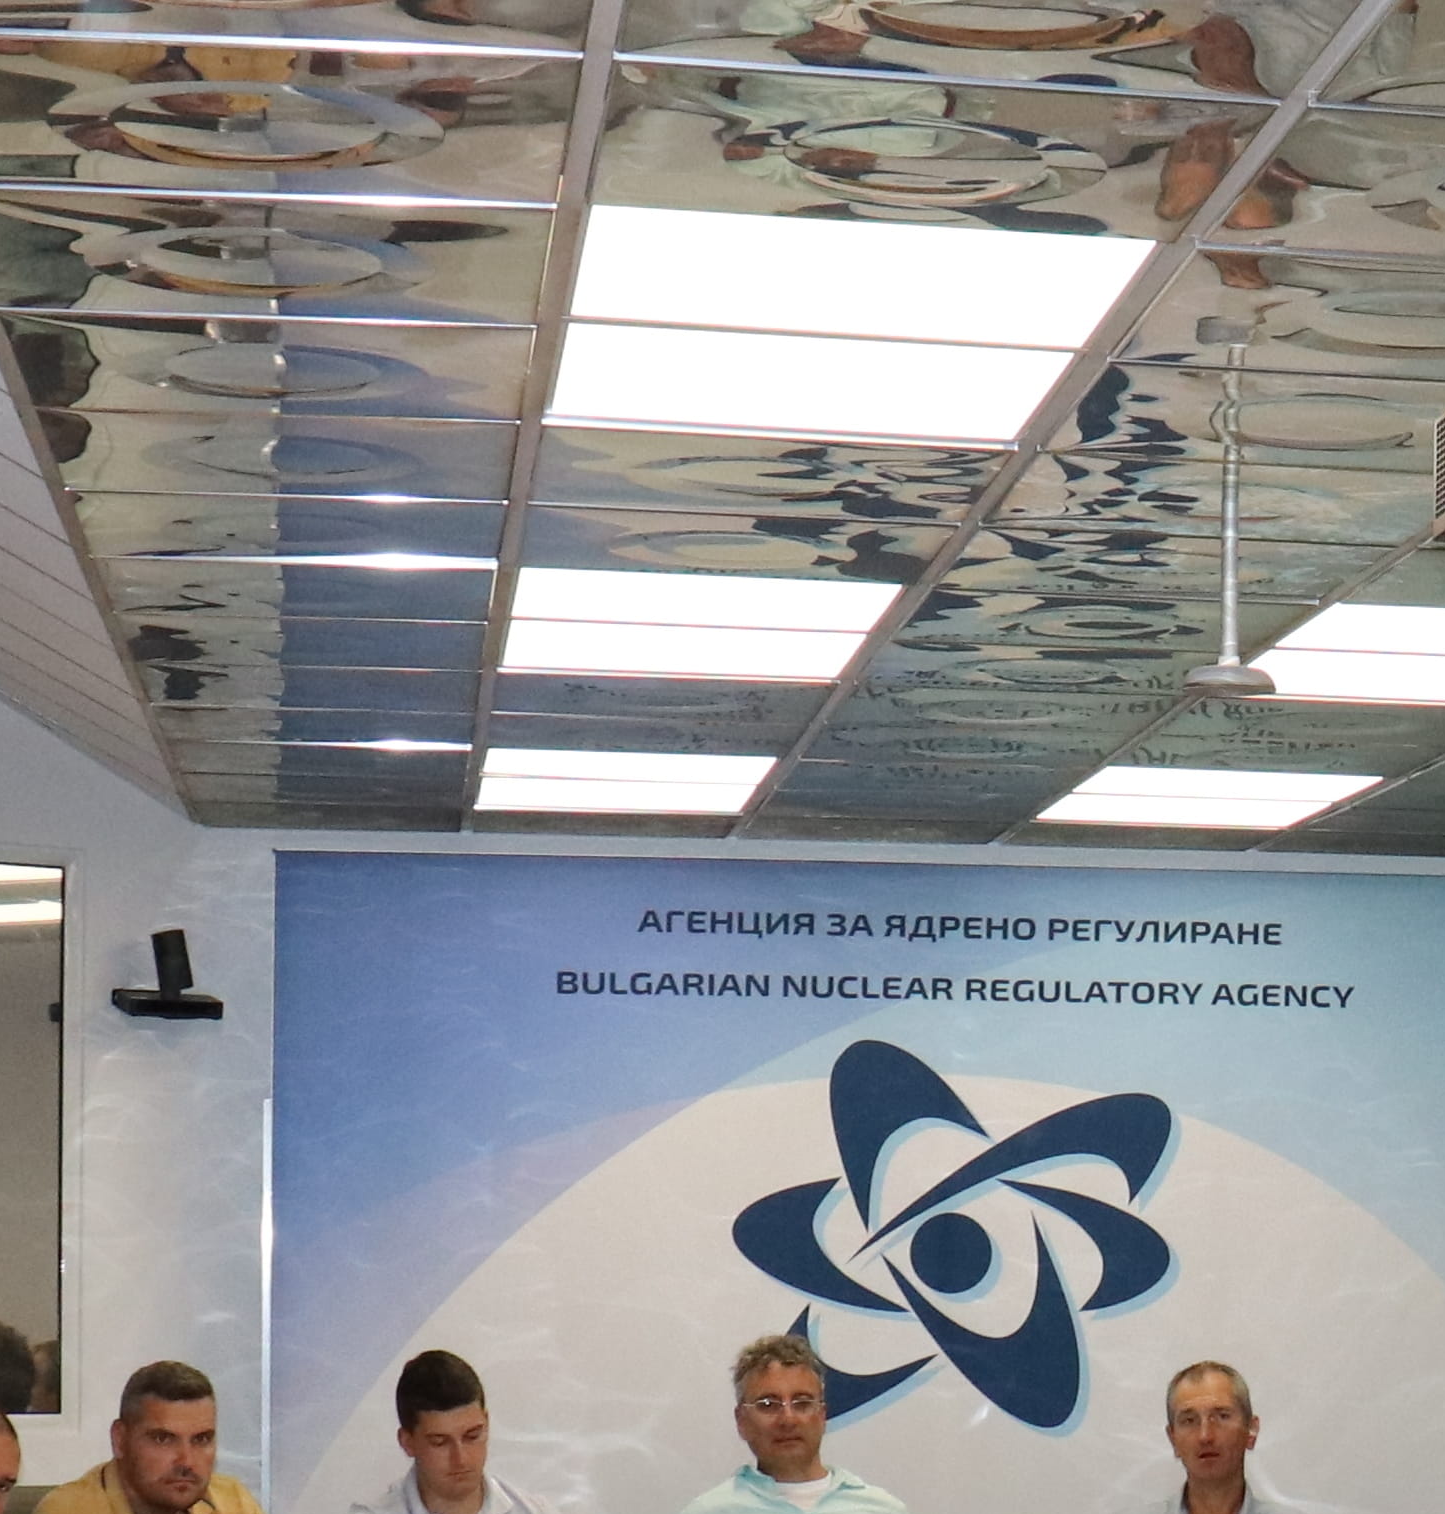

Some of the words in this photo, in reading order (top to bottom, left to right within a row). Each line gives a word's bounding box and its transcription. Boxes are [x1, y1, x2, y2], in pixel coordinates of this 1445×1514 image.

[637, 909, 815, 938] АГЕНЦИЯ
[826, 913, 873, 937] ЗА
[884, 914, 1036, 942] ЯДРЕНО
[1048, 918, 1283, 946] РЕГУЛИРАНЕ
[555, 970, 771, 998] BULGARIAN
[782, 974, 954, 1001] NUCLEAR
[965, 978, 1204, 1006] REGULATORY
[1211, 982, 1355, 1009] AGENCY
